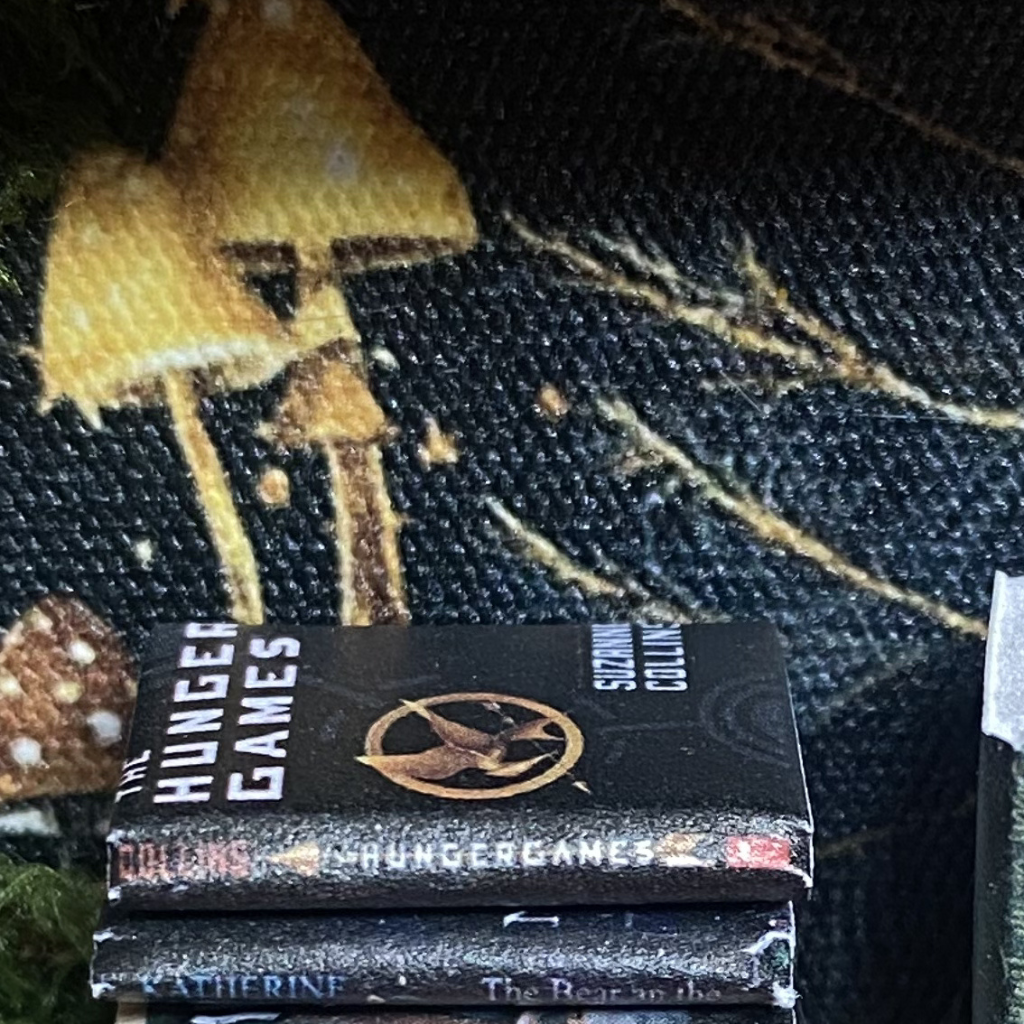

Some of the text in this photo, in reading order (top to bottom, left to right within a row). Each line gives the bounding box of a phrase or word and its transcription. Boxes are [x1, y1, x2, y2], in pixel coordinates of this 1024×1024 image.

[591, 622, 637, 691] SUZANN
[226, 637, 301, 801] GAMES
[481, 976, 540, 1001] The
